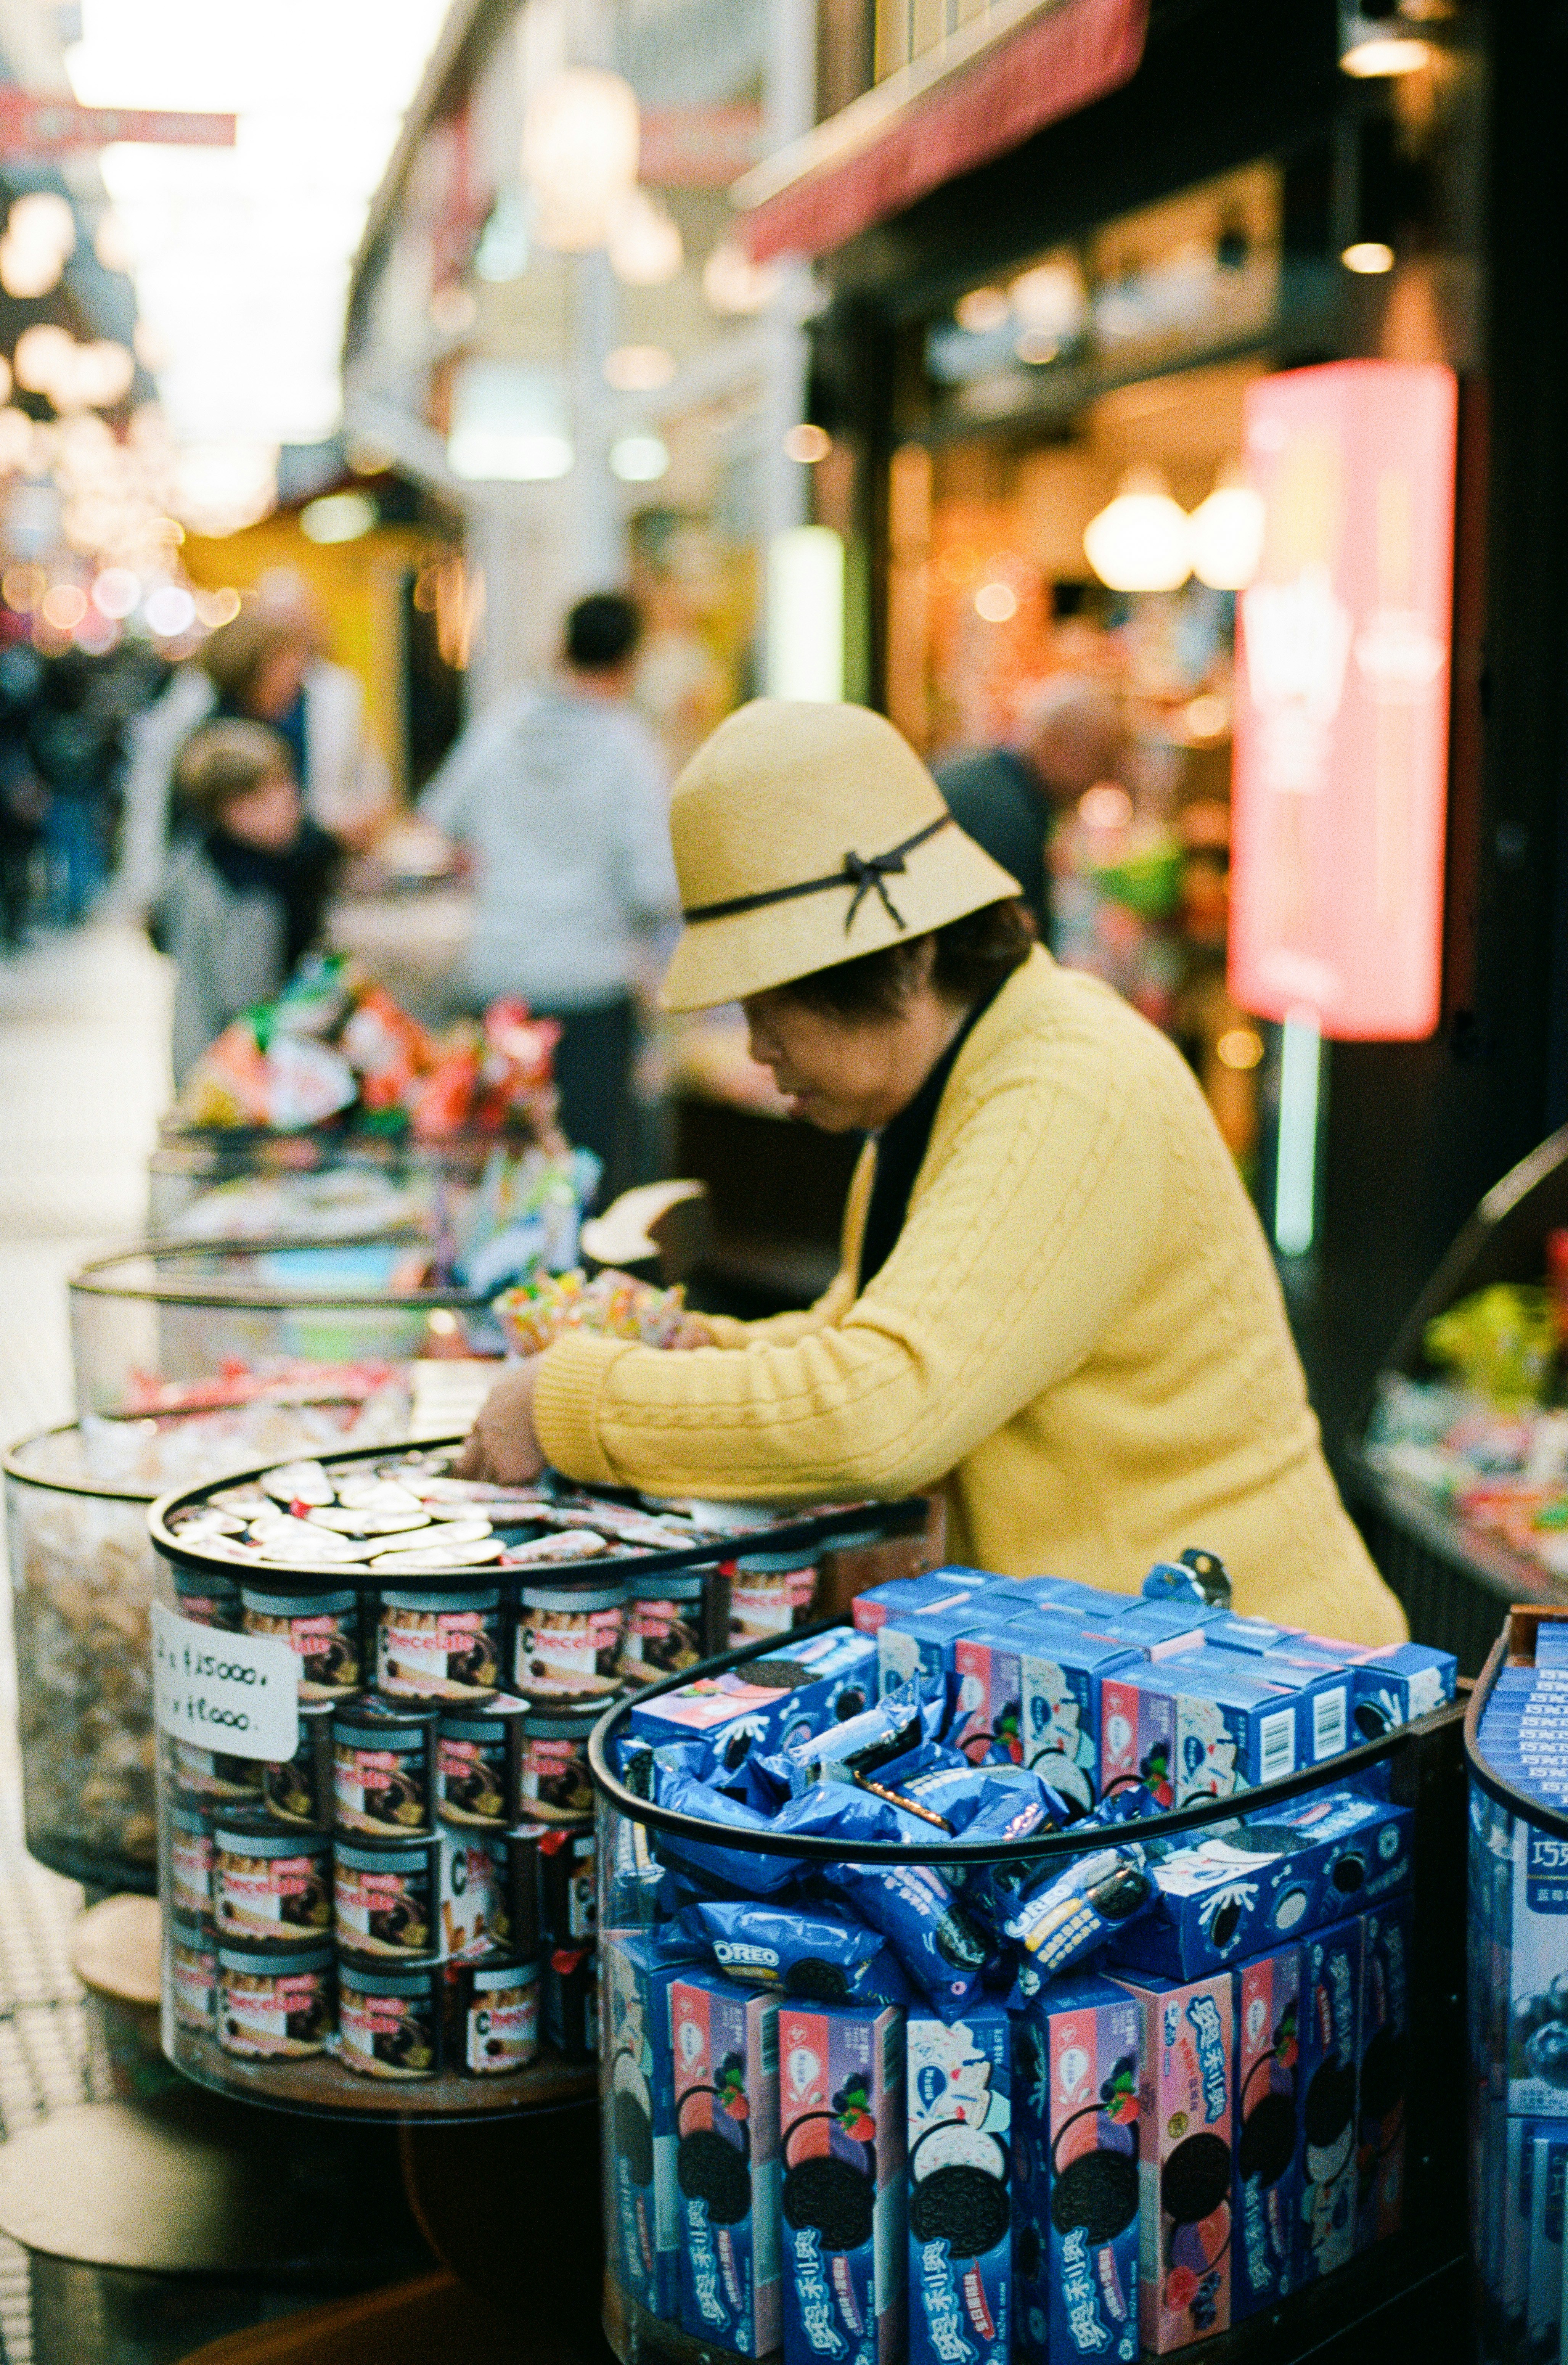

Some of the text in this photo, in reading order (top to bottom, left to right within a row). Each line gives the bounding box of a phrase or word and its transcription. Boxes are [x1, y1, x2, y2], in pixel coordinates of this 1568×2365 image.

[713, 1941, 778, 1965] OREO
[796, 2230, 843, 2355] 奥利奥
[922, 2241, 972, 2364] 奥利奥
[1063, 2229, 1107, 2349] 奥利奥
